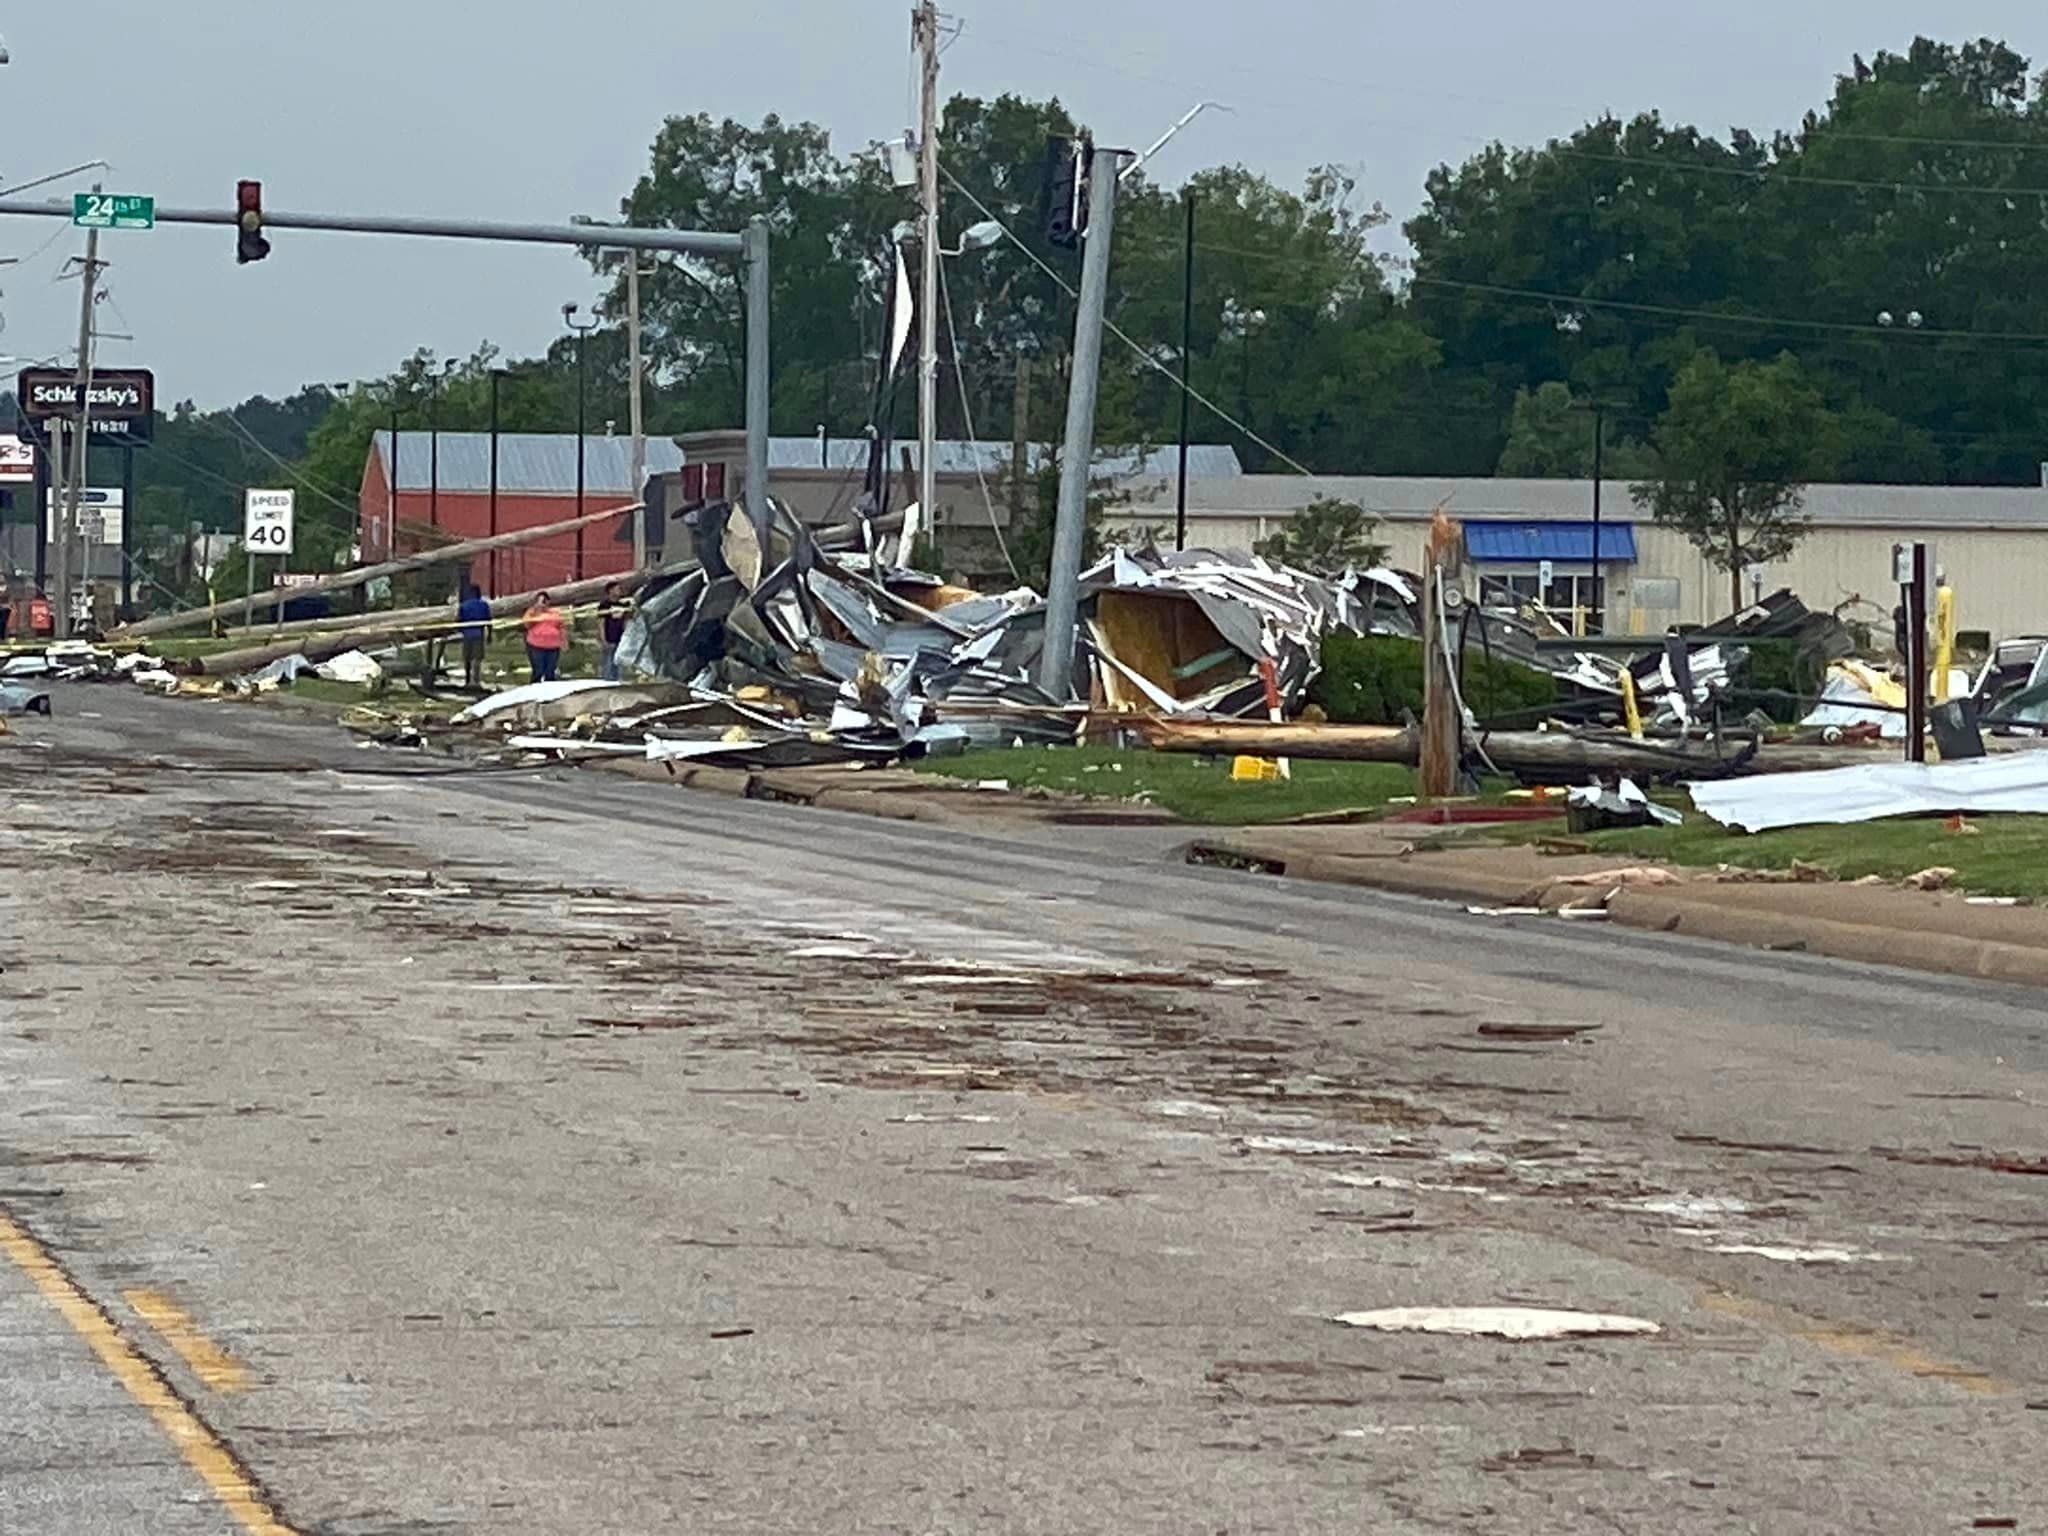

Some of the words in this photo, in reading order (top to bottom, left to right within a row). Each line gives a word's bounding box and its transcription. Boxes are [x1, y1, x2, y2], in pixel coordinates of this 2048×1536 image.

[251, 496, 290, 507] SPEED
[254, 511, 284, 520] LIMIT
[249, 526, 286, 545] 40
